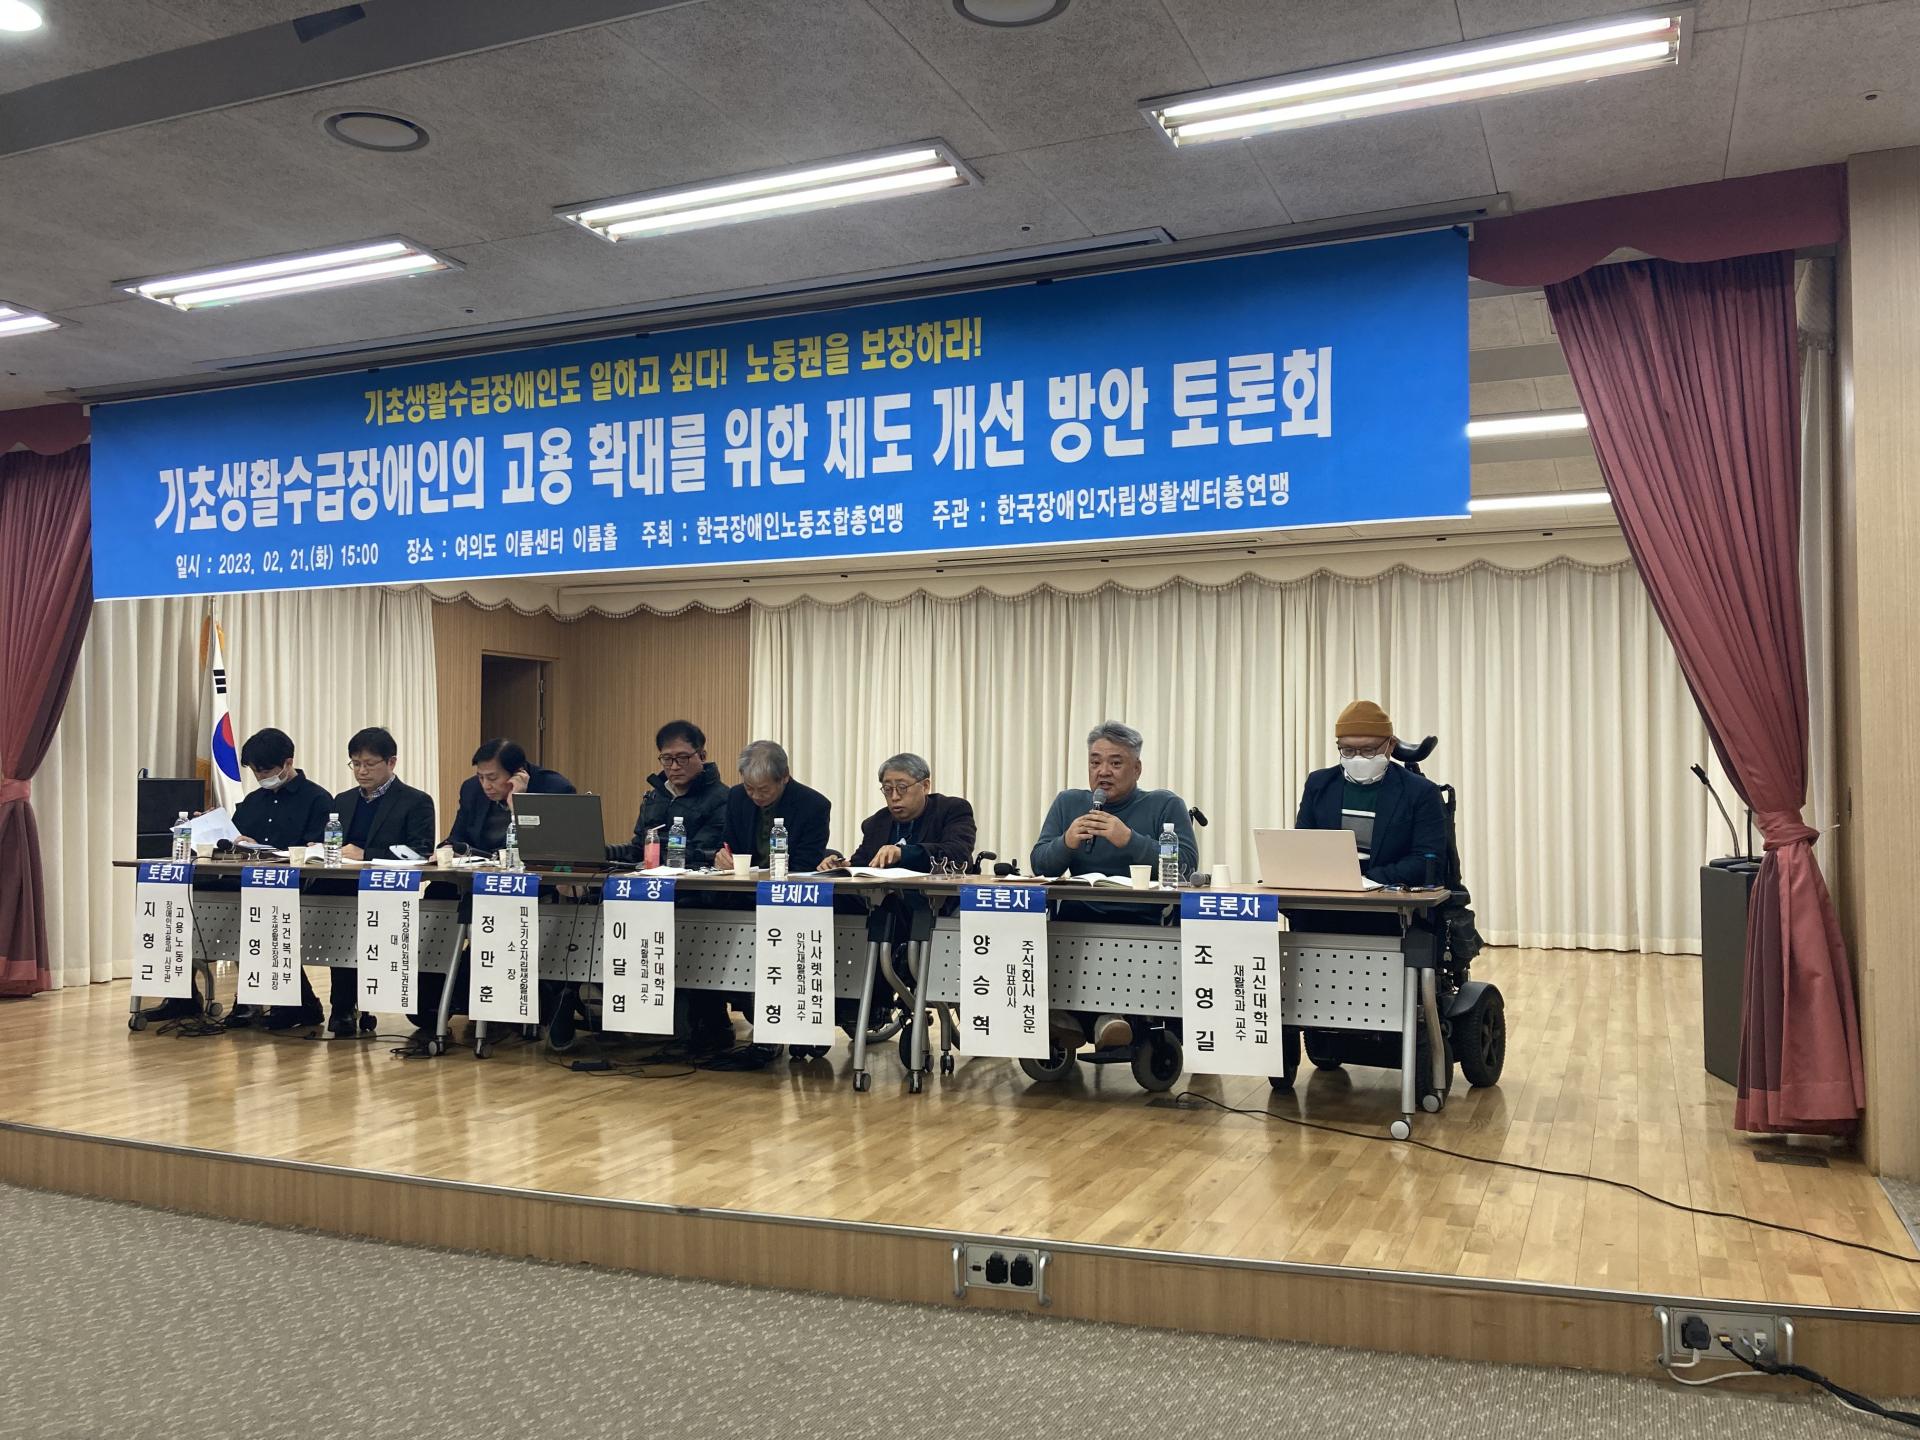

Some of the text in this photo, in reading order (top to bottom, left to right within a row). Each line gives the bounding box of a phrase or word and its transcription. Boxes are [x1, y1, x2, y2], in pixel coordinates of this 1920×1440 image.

[364, 316, 982, 426] 기초생활수급장애인도 일하고 싶다! 노동권을 보장하라!
[154, 346, 1333, 534] 기초생활수급장애인의 고용 확대를 위한 제도 개선 방안 토론회
[641, 519, 673, 549] 주최
[696, 502, 903, 545] 한국장애인노동조합총연맹
[932, 497, 970, 530] 주관
[997, 471, 1290, 526] 한국장애인자립생활센터총연맹
[175, 553, 201, 579] 일시
[341, 542, 379, 567] 15:00
[406, 537, 434, 565] 장소
[455, 533, 497, 560] 여의도
[505, 527, 564, 557] 이룸센터
[573, 522, 618, 553] 이룸홀
[148, 864, 184, 882] 토론자
[251, 869, 290, 887] 토론자
[370, 871, 410, 889] 토론자
[484, 875, 527, 894] 토론자
[770, 884, 819, 904] 발제자
[975, 888, 1030, 910] 토론자
[1198, 896, 1260, 918] 토론자
[141, 901, 156, 981] 지형근
[175, 907, 185, 977] 고용노동부
[247, 906, 261, 989] 민영신
[282, 912, 292, 985] 보건복지부
[366, 910, 379, 995] 김선규
[479, 915, 495, 1003] 정만훈
[519, 906, 529, 1017] 피노키오자립생활센터
[612, 922, 627, 1013] 이달엽
[640, 938, 649, 1004] 재활학과 교수
[653, 931, 665, 1006] 대구대학교
[765, 928, 781, 1024] 우주형
[796, 932, 806, 1021] 인간재활학과 교수
[810, 929, 823, 1024] 나사렛대학교
[972, 934, 991, 1035] 양승혁
[1006, 963, 1017, 1008] 대표이사
[1021, 940, 1035, 1034] 주식회사 천운
[1194, 945, 1214, 1052] 조영길
[1233, 964, 1247, 1041] 재활학과 교수
[1252, 956, 1268, 1045] 고신대학교
